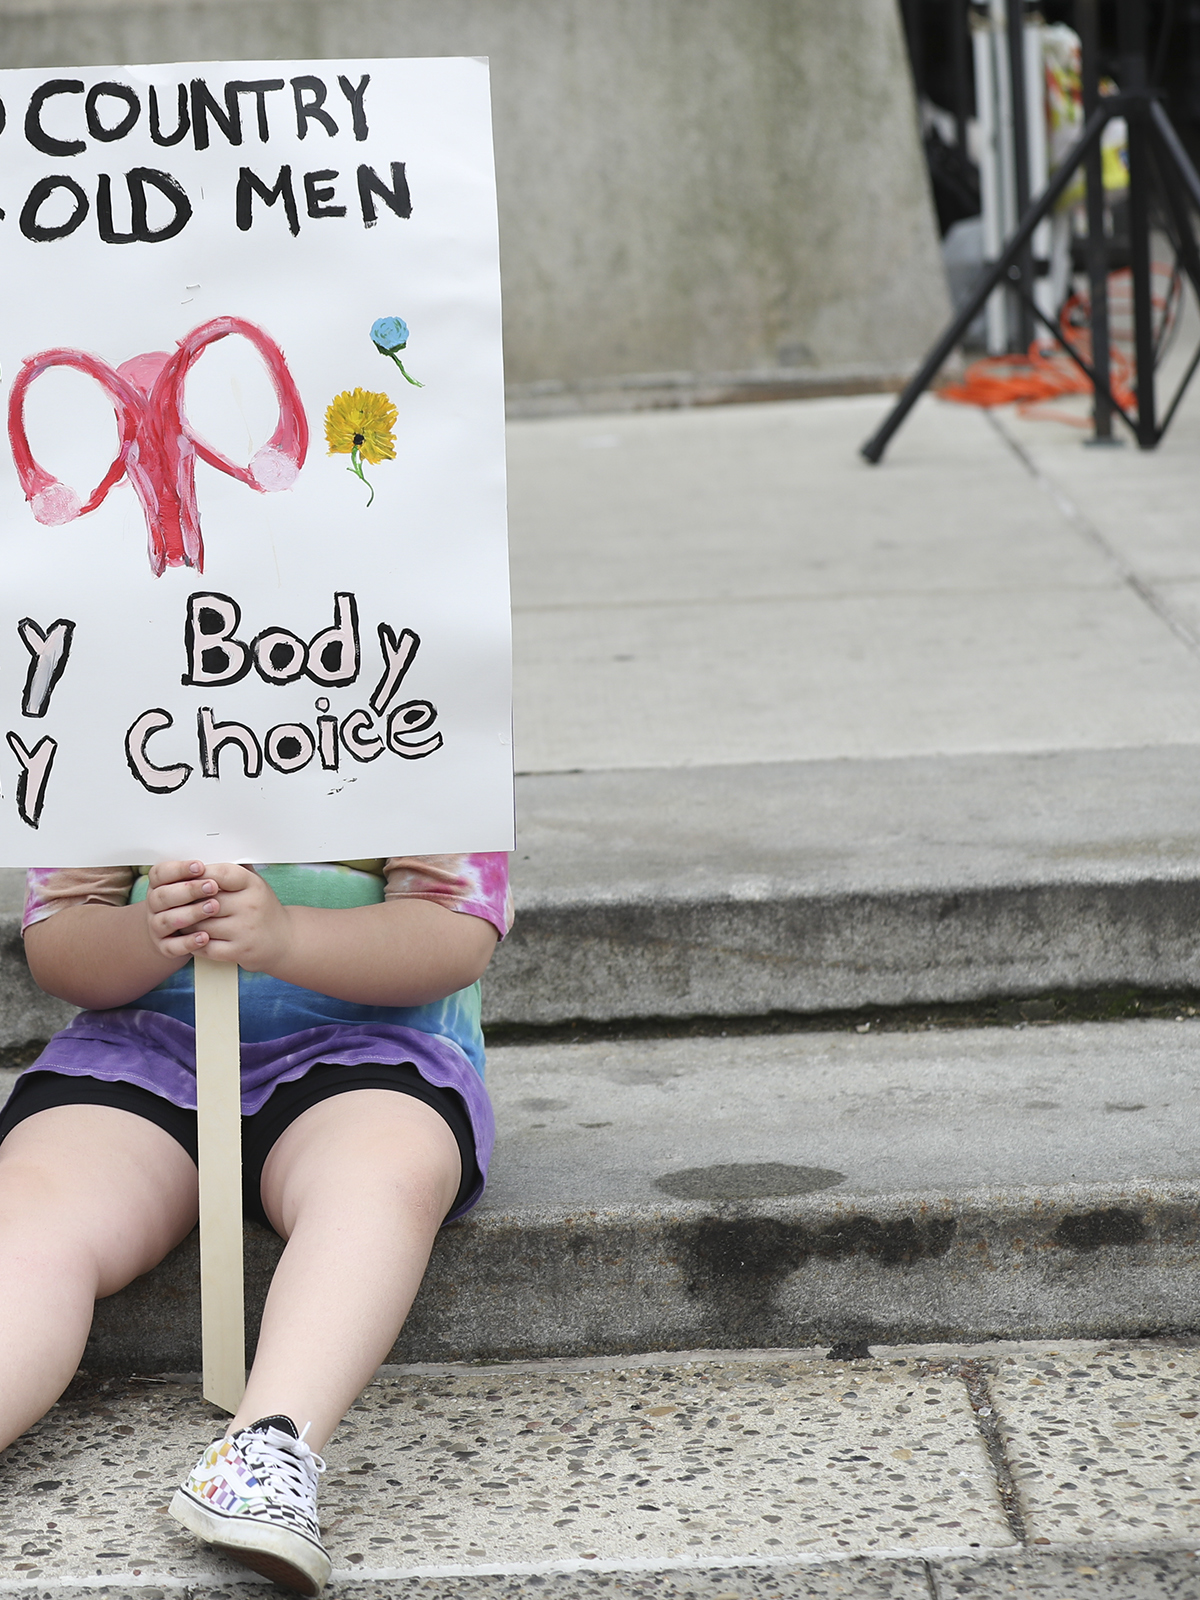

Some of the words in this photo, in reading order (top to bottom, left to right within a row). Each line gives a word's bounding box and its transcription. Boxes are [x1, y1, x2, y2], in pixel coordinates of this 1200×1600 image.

[23, 73, 372, 157] COUNTRY
[19, 166, 193, 244] OLD
[235, 161, 414, 238] MEN
[180, 590, 420, 717] Body
[124, 697, 445, 794] Choice
